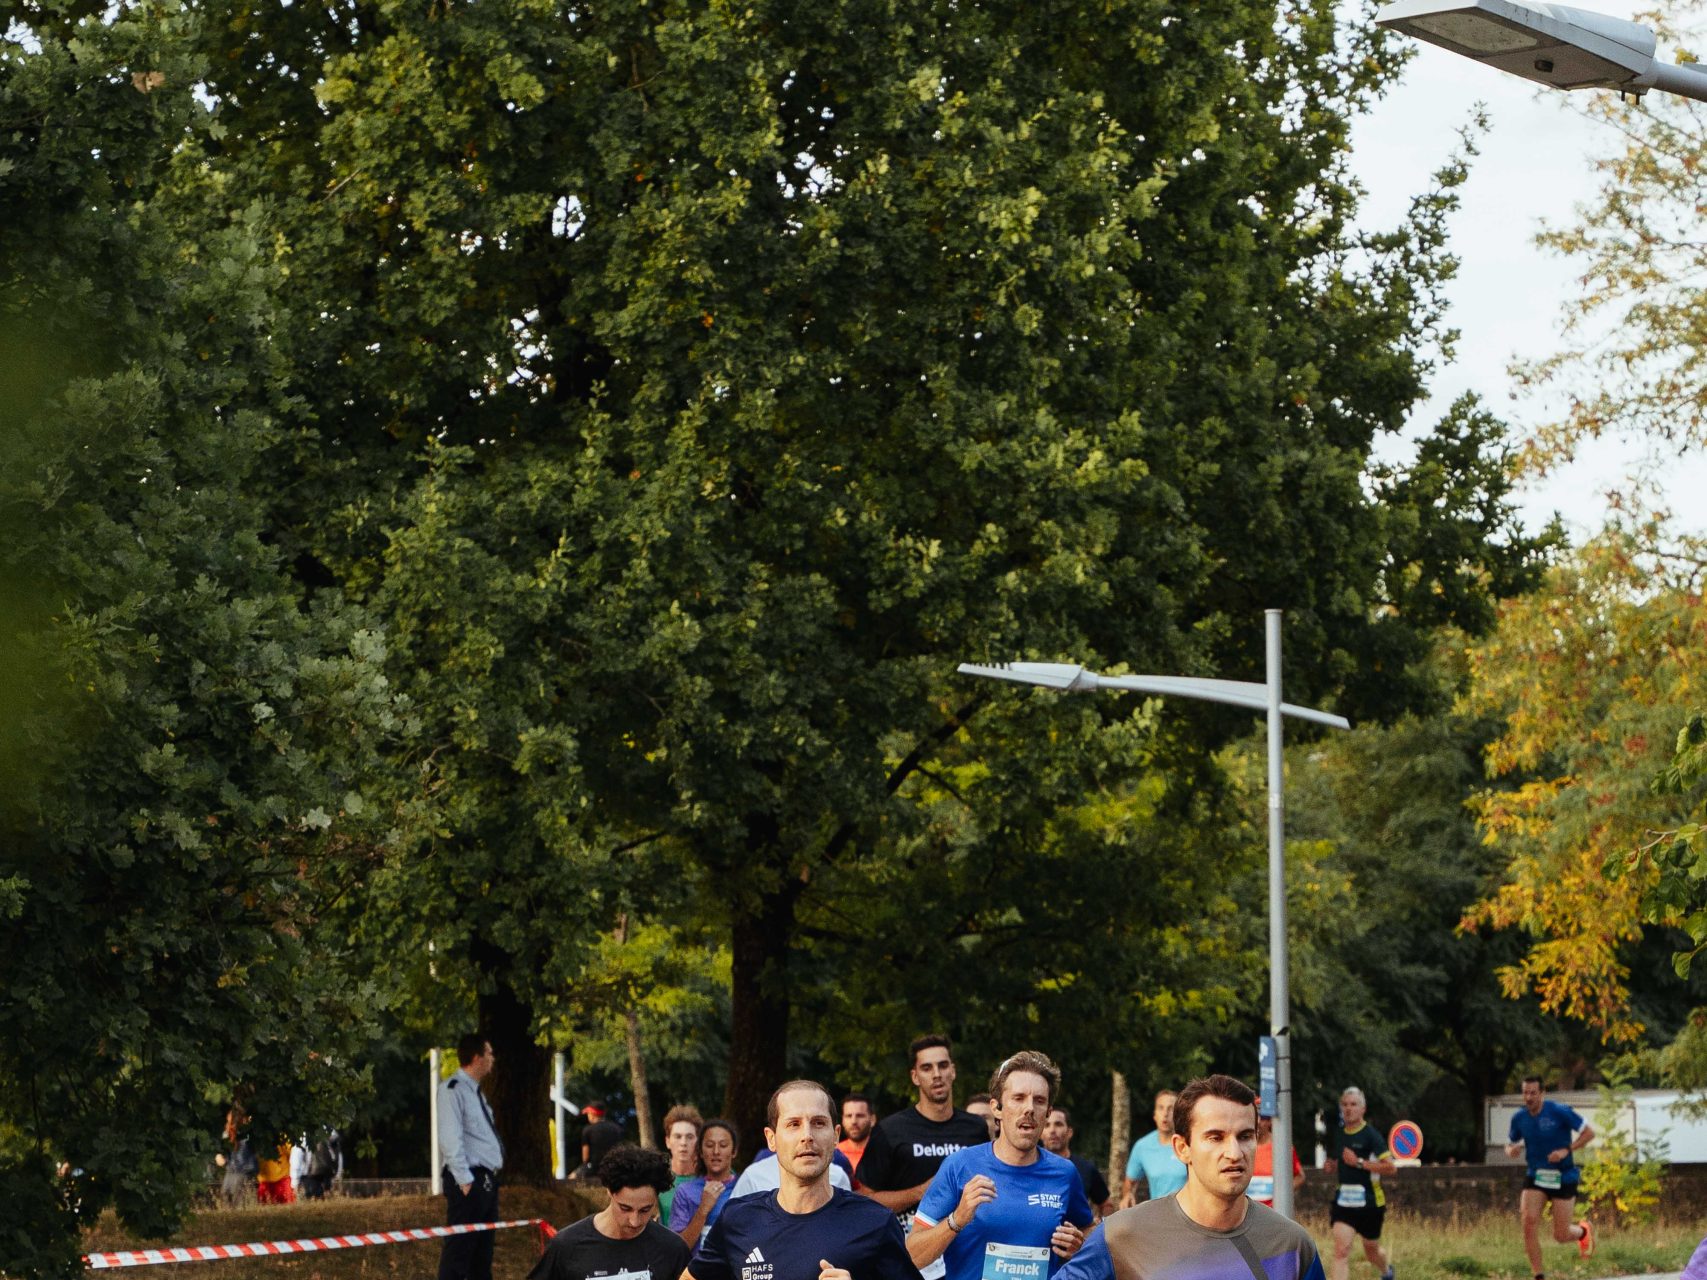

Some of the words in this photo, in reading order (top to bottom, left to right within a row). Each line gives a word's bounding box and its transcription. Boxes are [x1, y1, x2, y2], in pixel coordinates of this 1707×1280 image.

[752, 1264, 774, 1272] HAFS
[995, 1259, 1040, 1276] Franck
[752, 1273, 773, 1280] Group
